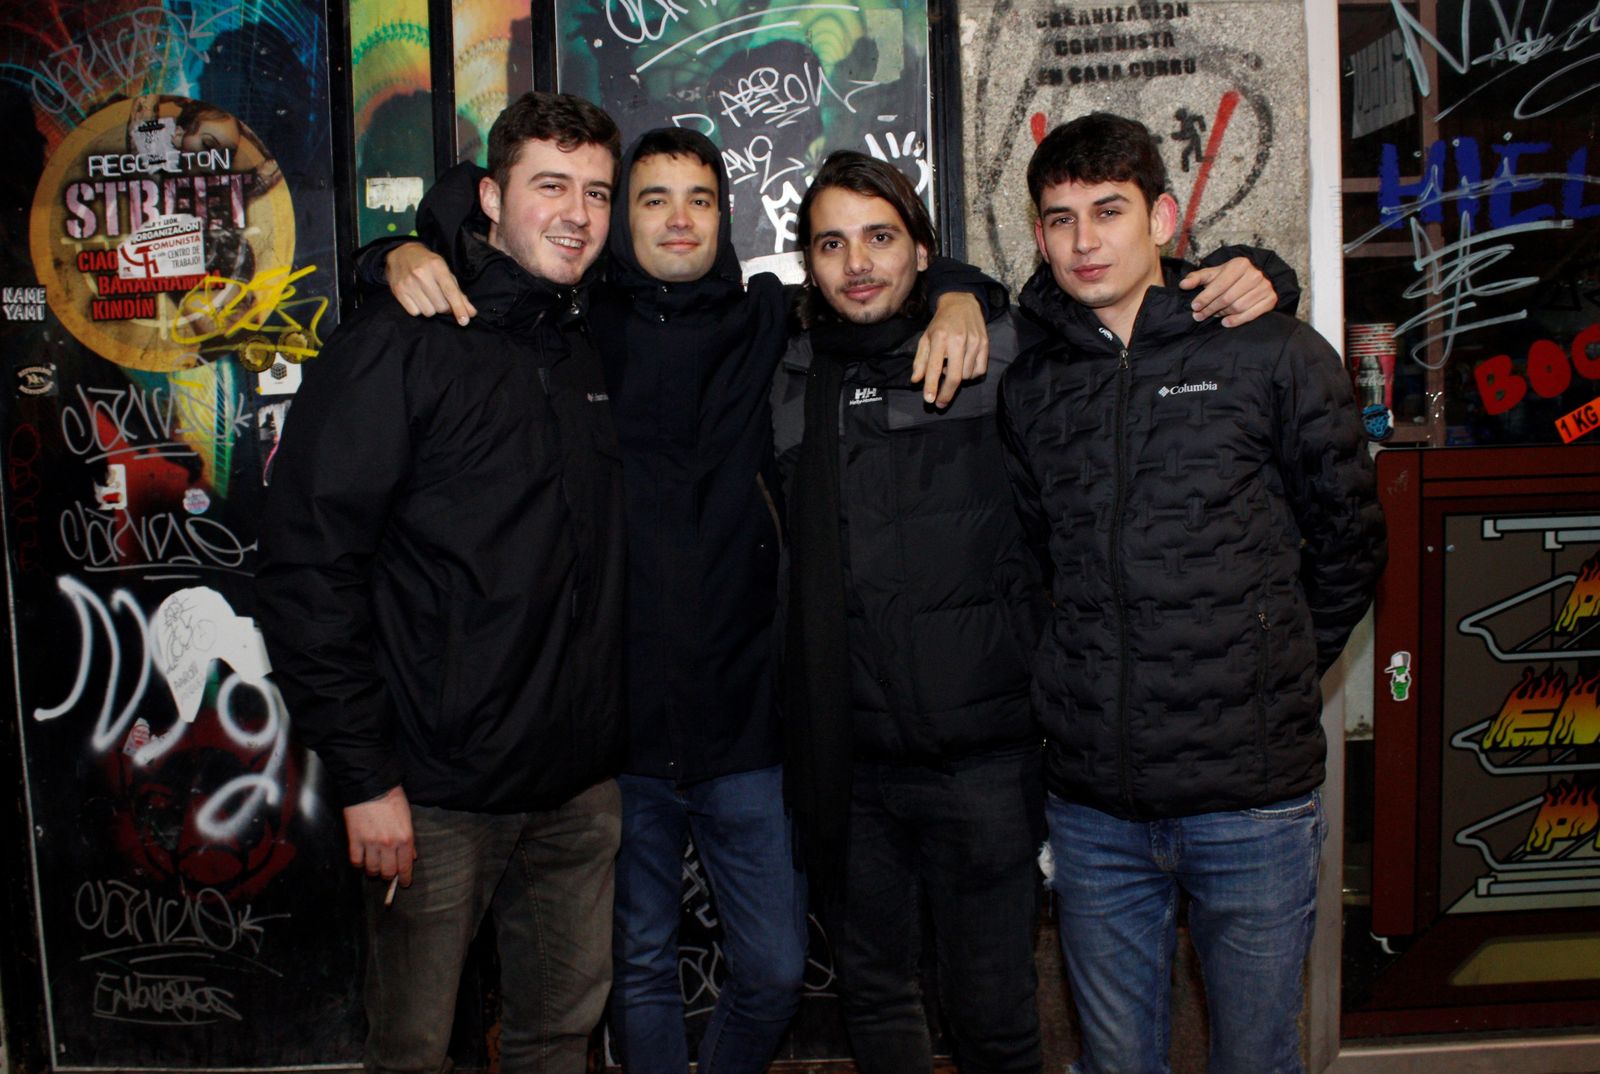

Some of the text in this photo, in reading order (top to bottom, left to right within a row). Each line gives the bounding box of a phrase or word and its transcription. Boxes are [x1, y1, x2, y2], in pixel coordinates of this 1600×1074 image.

[78, 251, 118, 271] CIAO
[855, 387, 876, 399] HH
[1170, 381, 1217, 395] Columbia
[1571, 405, 1599, 433] KG
